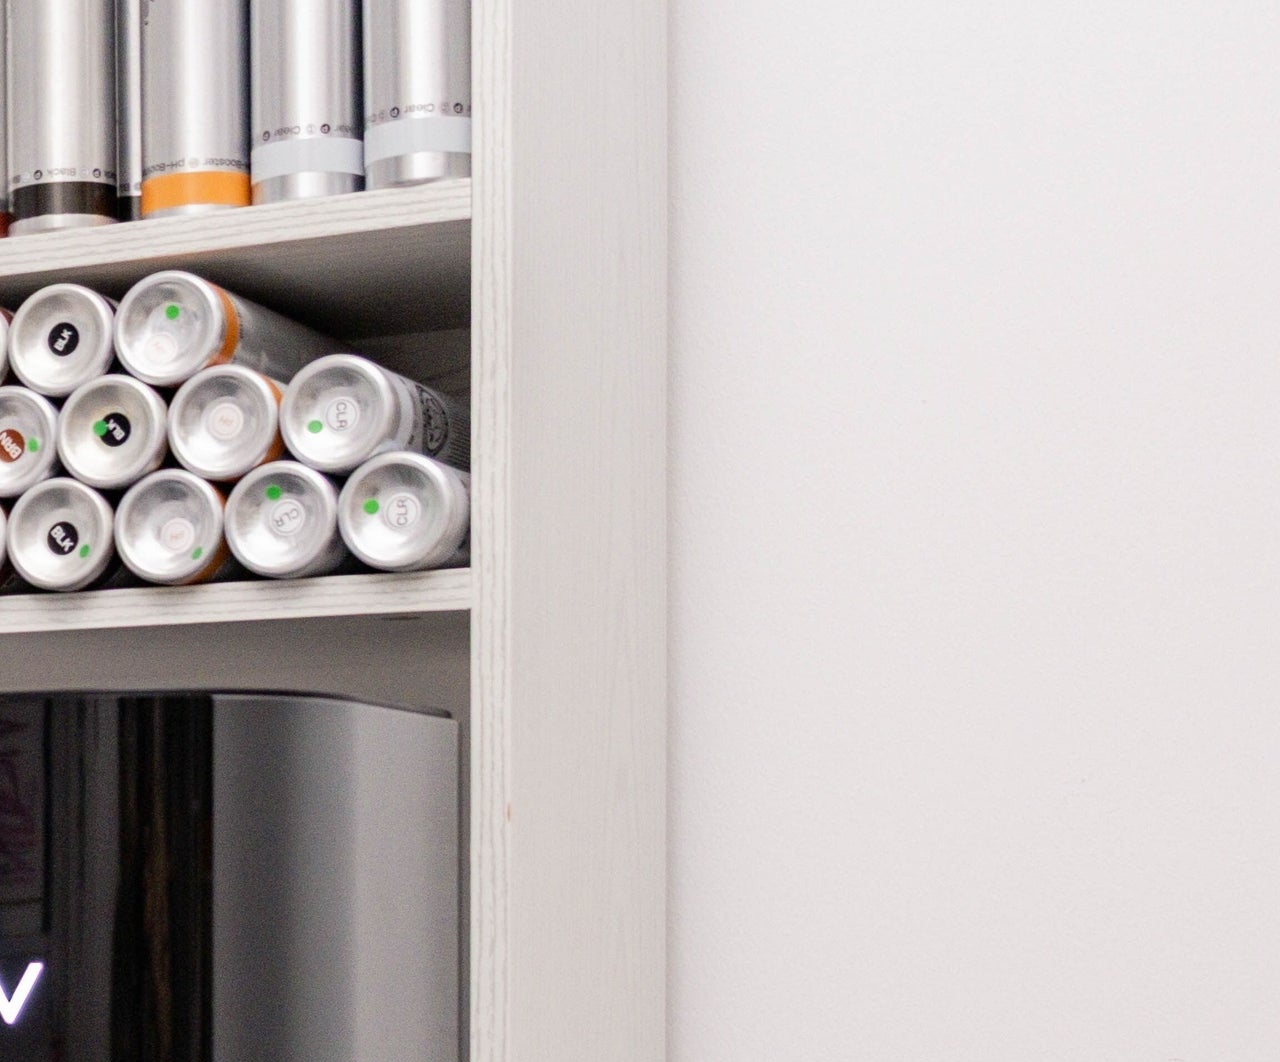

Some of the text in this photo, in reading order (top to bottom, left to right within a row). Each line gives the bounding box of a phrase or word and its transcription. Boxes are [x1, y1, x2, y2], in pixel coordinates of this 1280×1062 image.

[53, 329, 73, 351] BLK
[336, 402, 348, 429] CLR
[275, 507, 300, 528] CLR
[396, 499, 408, 526] CLR
[50, 525, 74, 552] BLK
